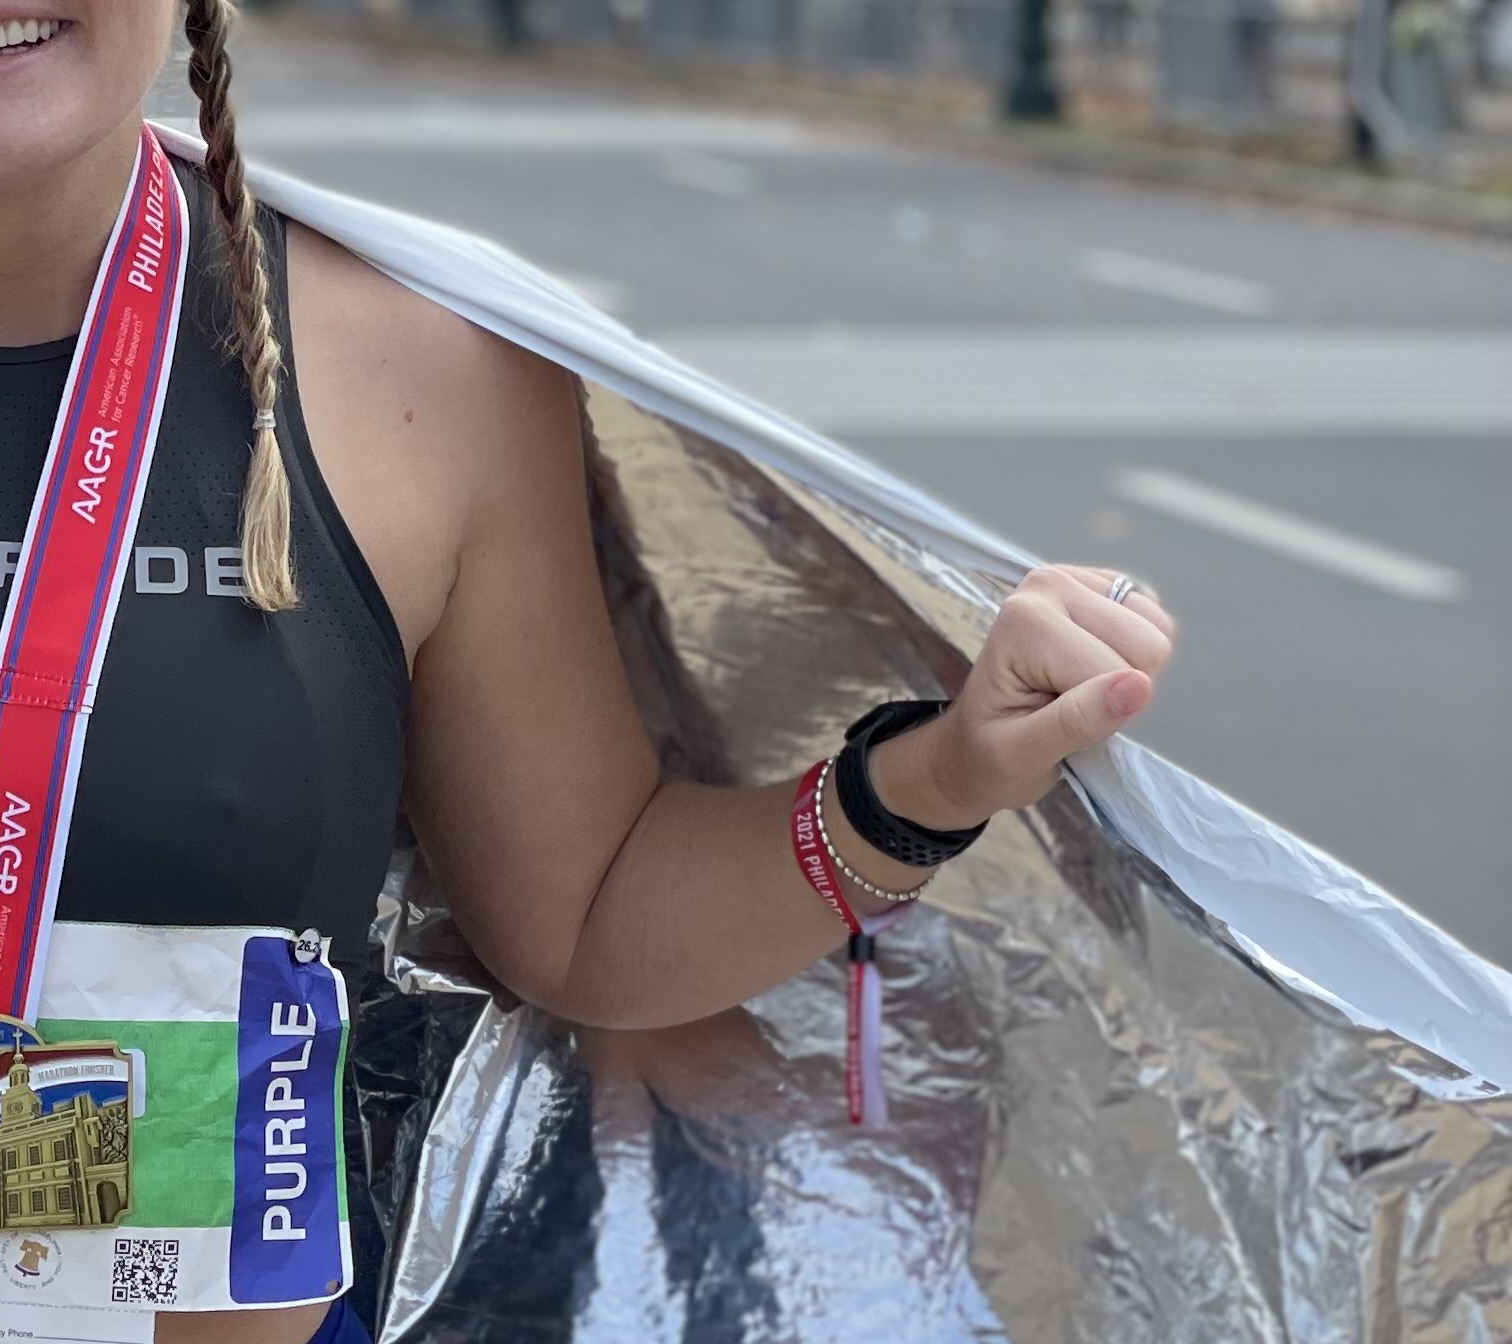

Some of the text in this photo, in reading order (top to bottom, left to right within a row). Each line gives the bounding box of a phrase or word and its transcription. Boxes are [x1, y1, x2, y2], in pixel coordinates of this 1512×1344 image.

[98, 368, 116, 418] American
[115, 369, 132, 405] Cancer
[111, 407, 123, 423] for
[71, 426, 118, 524] AACR
[797, 812, 816, 850] 2021
[262, 1002, 317, 1242] PURPLE
[8, 1329, 34, 1339] Phone
